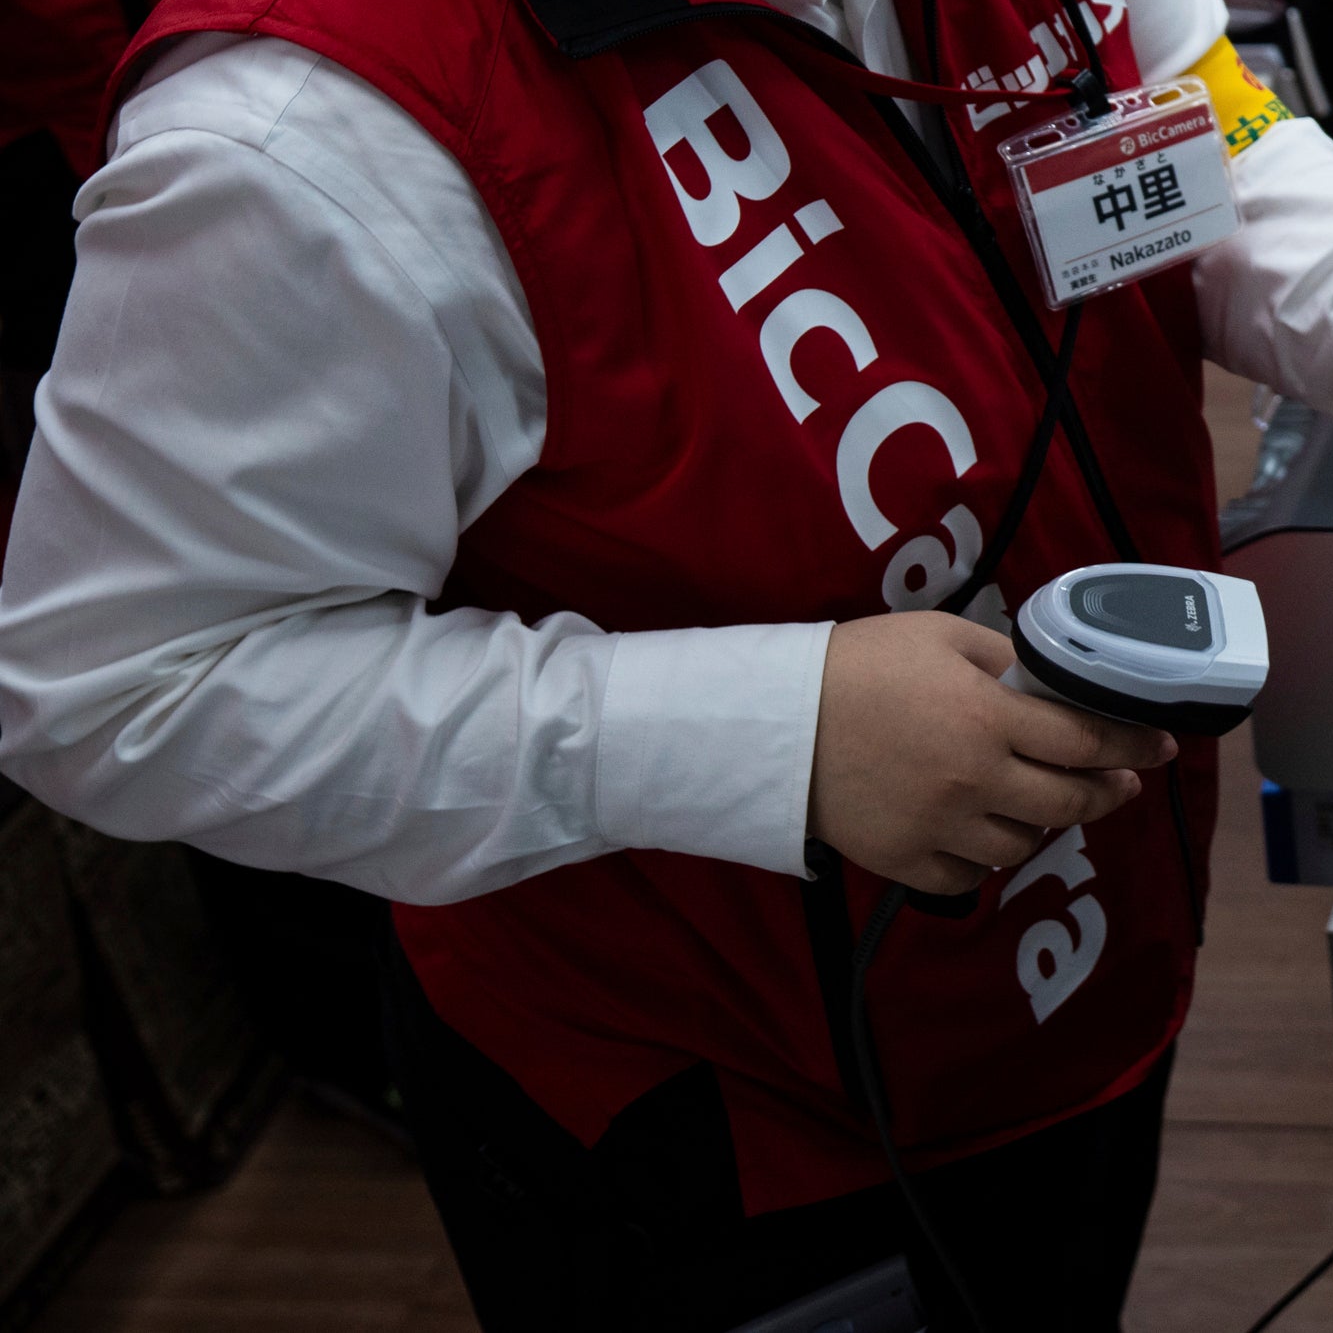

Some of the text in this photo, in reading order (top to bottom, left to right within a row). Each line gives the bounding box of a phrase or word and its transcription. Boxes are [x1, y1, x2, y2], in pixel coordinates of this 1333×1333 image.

[1138, 115, 1206, 148] BicCamera
[1093, 163, 1186, 233] 中里
[1109, 227, 1192, 271] Nakazato
[644, 59, 1107, 1024] BicCara
[1186, 595, 1194, 620] ZEBRA
